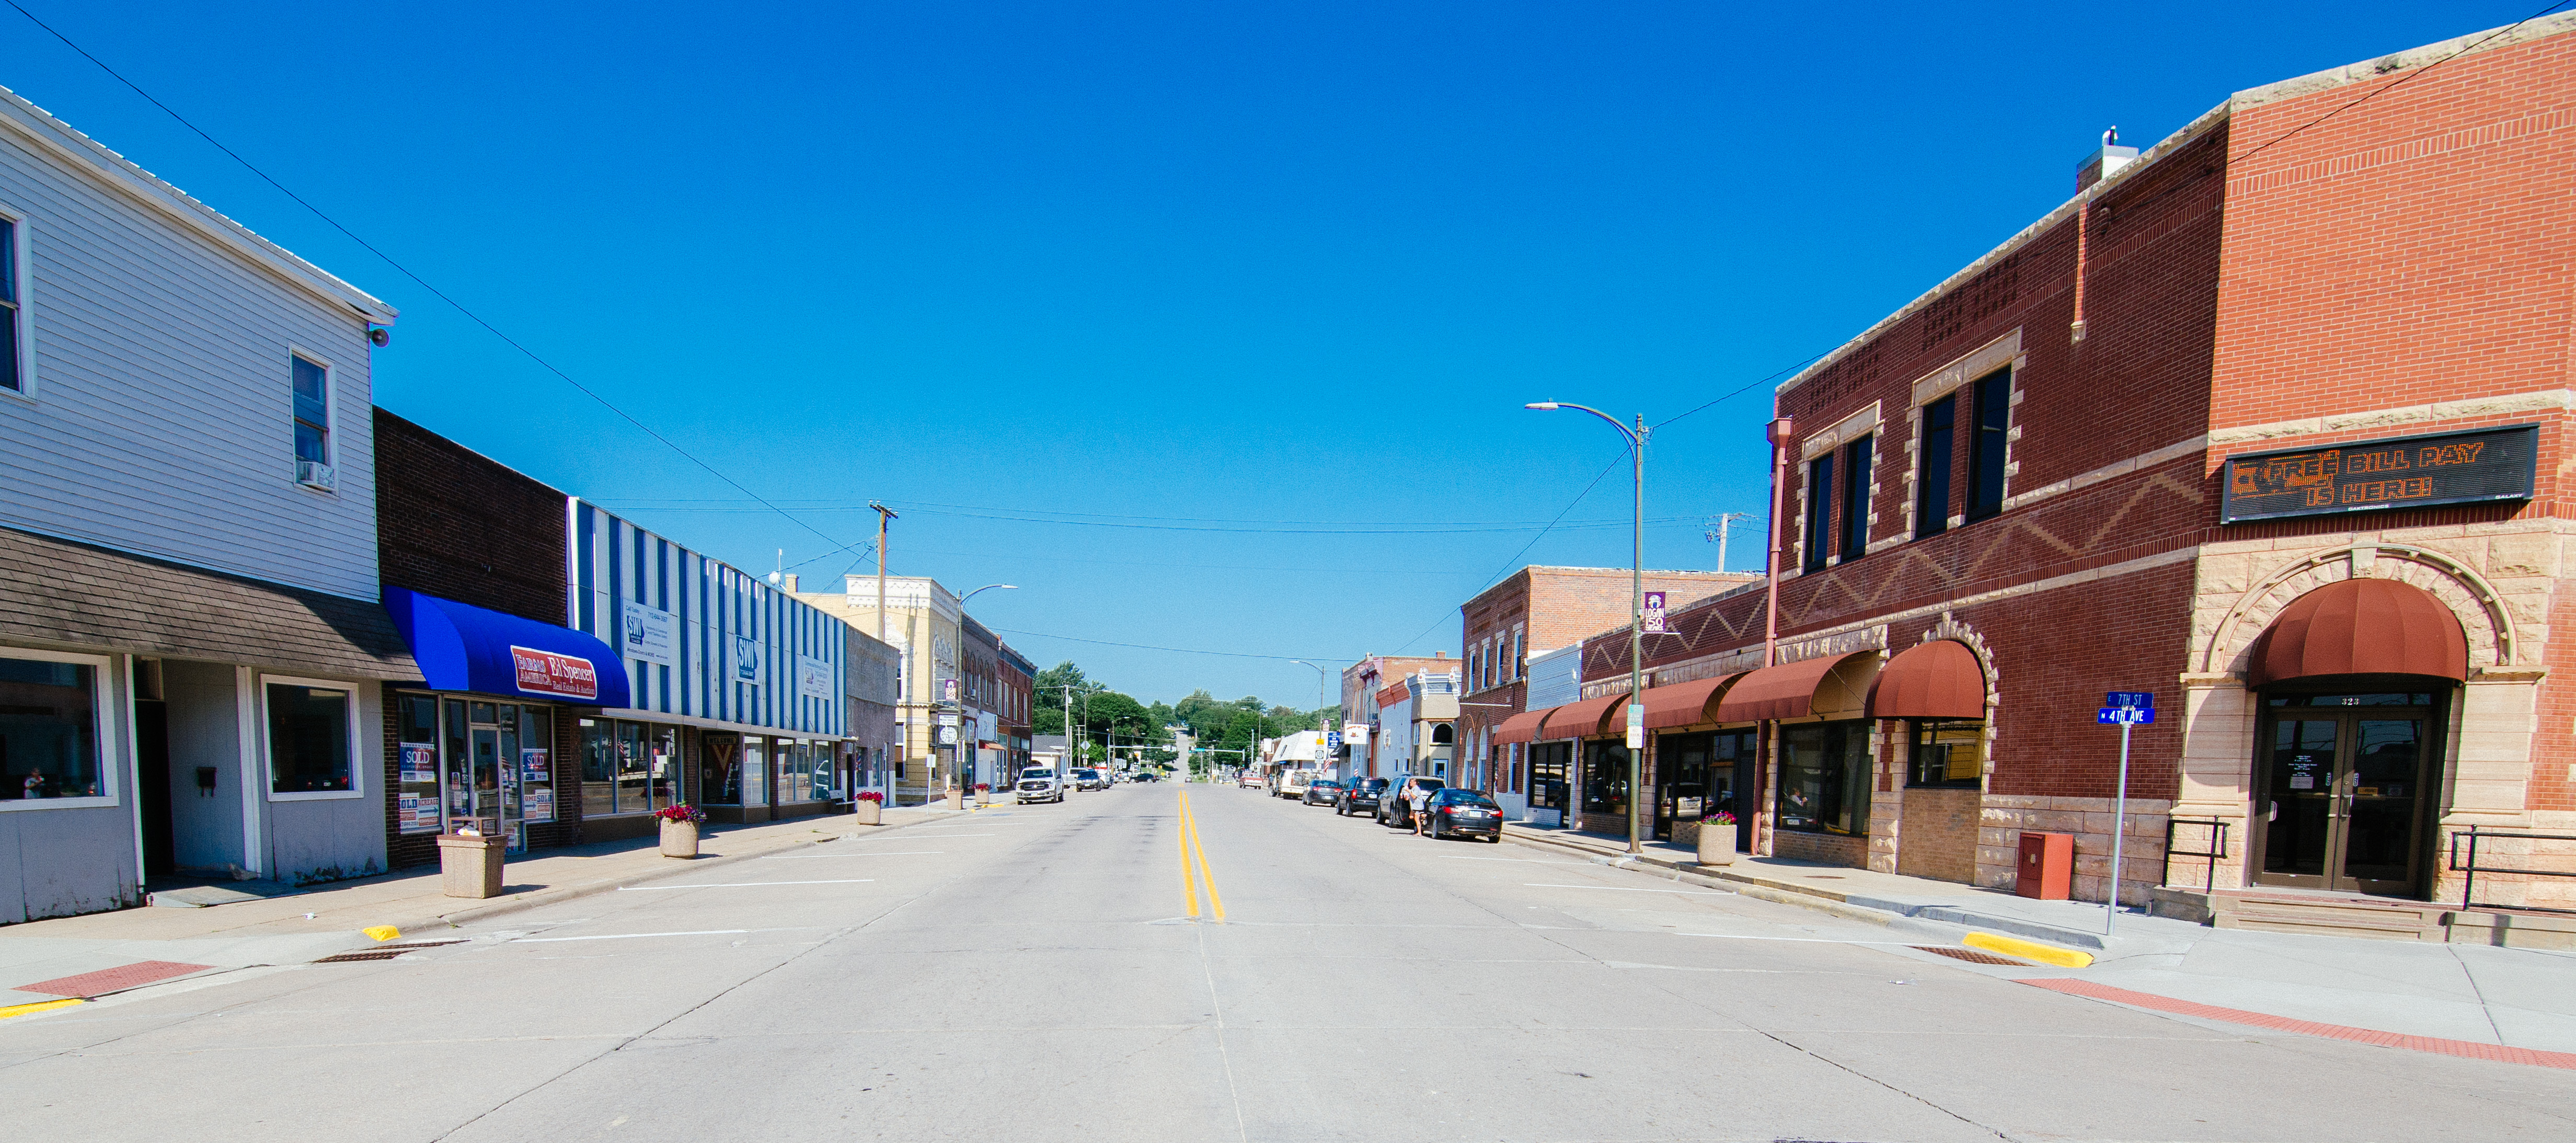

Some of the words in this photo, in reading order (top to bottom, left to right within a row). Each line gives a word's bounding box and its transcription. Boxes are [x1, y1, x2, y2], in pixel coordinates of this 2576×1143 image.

[2268, 450, 2339, 482] FREE
[2348, 450, 2410, 474] BILL
[2419, 442, 2483, 467] PAY
[2306, 487, 2334, 506] IS
[2342, 477, 2432, 504] HERE!
[2348, 504, 2390, 512] DAKTRONICS
[1645, 608, 1664, 618] LOGAN
[628, 615, 642, 636] SWI
[1646, 618, 1663, 626] 150
[738, 638, 754, 668] SWI
[515, 654, 546, 673] FARMS
[519, 669, 552, 685] AMERICA
[561, 659, 593, 683] Spencer
[553, 680, 562, 691] Real
[563, 682, 576, 692] Estate
[576, 684, 580, 693] &
[580, 685, 595, 695] Auction
[2118, 694, 2131, 705] 7TH
[2133, 694, 2142, 705] ST
[2109, 710, 2126, 722] 4TH
[2129, 710, 2144, 722] AVE
[406, 751, 430, 763] SOLD
[527, 755, 544, 766] SOLD
[399, 799, 418, 809] OLD
[537, 794, 552, 803] SOLD
